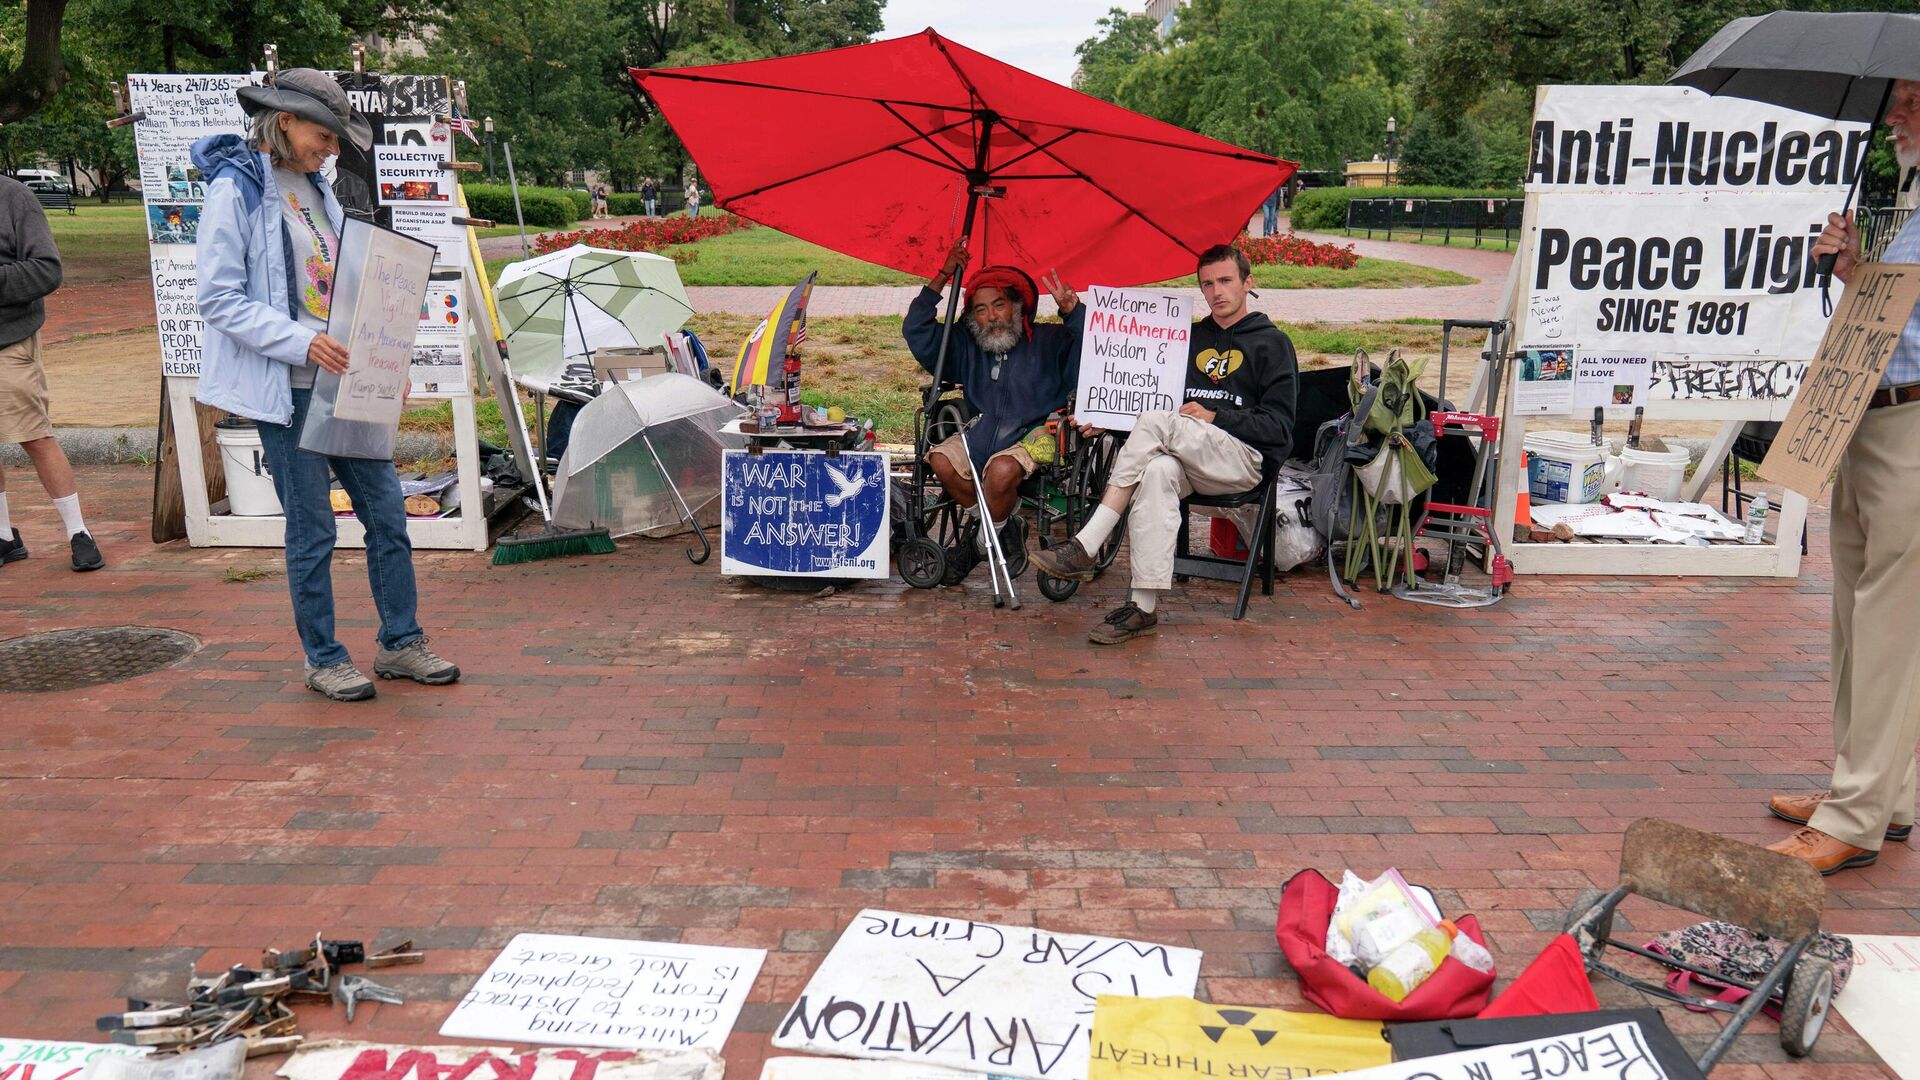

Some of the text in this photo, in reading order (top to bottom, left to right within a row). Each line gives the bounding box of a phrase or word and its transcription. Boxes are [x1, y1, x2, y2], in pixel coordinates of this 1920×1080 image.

[151, 79, 182, 93] Years
[146, 106, 167, 115] June
[190, 106, 209, 115] 1981
[194, 94, 220, 106] Peace
[220, 93, 239, 107] Vigi
[138, 118, 167, 128] William
[170, 117, 200, 128] Thomas
[379, 153, 445, 162] COLLECTIVE
[1527, 118, 1871, 186] Anti-Nuclear
[380, 169, 445, 178] SECURITY??
[1535, 224, 1831, 295] Peace Vigi
[156, 274, 197, 290] Congres
[374, 255, 416, 295] The Peace
[158, 304, 172, 315] OR
[1093, 288, 1179, 318] Welcome To
[1531, 295, 1541, 304] I
[1531, 305, 1562, 317] Never
[1845, 272, 1905, 324] HATE
[161, 319, 176, 332] OR
[179, 319, 192, 332] OF
[1088, 311, 1188, 342] MAGAmerica
[1596, 298, 1750, 336] SINCE 1981
[162, 333, 202, 349] PEOPL
[358, 322, 411, 352] An American
[1094, 335, 1168, 364] Wisdom &
[1855, 328, 1898, 373] MAKE
[165, 351, 173, 360] to
[368, 347, 406, 374] Treasure!
[349, 370, 375, 401] Trump
[1103, 362, 1159, 394] Honesty
[1087, 386, 1174, 413] PROHIBITED
[1801, 365, 1870, 421] AMERICA
[1445, 414, 1479, 422] Milwaukee
[742, 462, 806, 489] WAR
[731, 495, 823, 515] IS NOT THE
[743, 521, 861, 548] ANSWER!
[814, 556, 876, 569] www.fcnl.org
[862, 915, 1173, 976] WAR Crime
[629, 958, 689, 979] Not
[917, 958, 987, 997] A
[491, 970, 727, 1004] From Pedophelia
[462, 990, 719, 1026] Cities to Distract
[528, 1011, 709, 1046] Militarizing
[779, 996, 1093, 1075] ARVATION
[8, 1044, 84, 1063] SAVE
[1092, 1041, 1218, 1076] THREAT
[1511, 1025, 1662, 1080] PEACE
